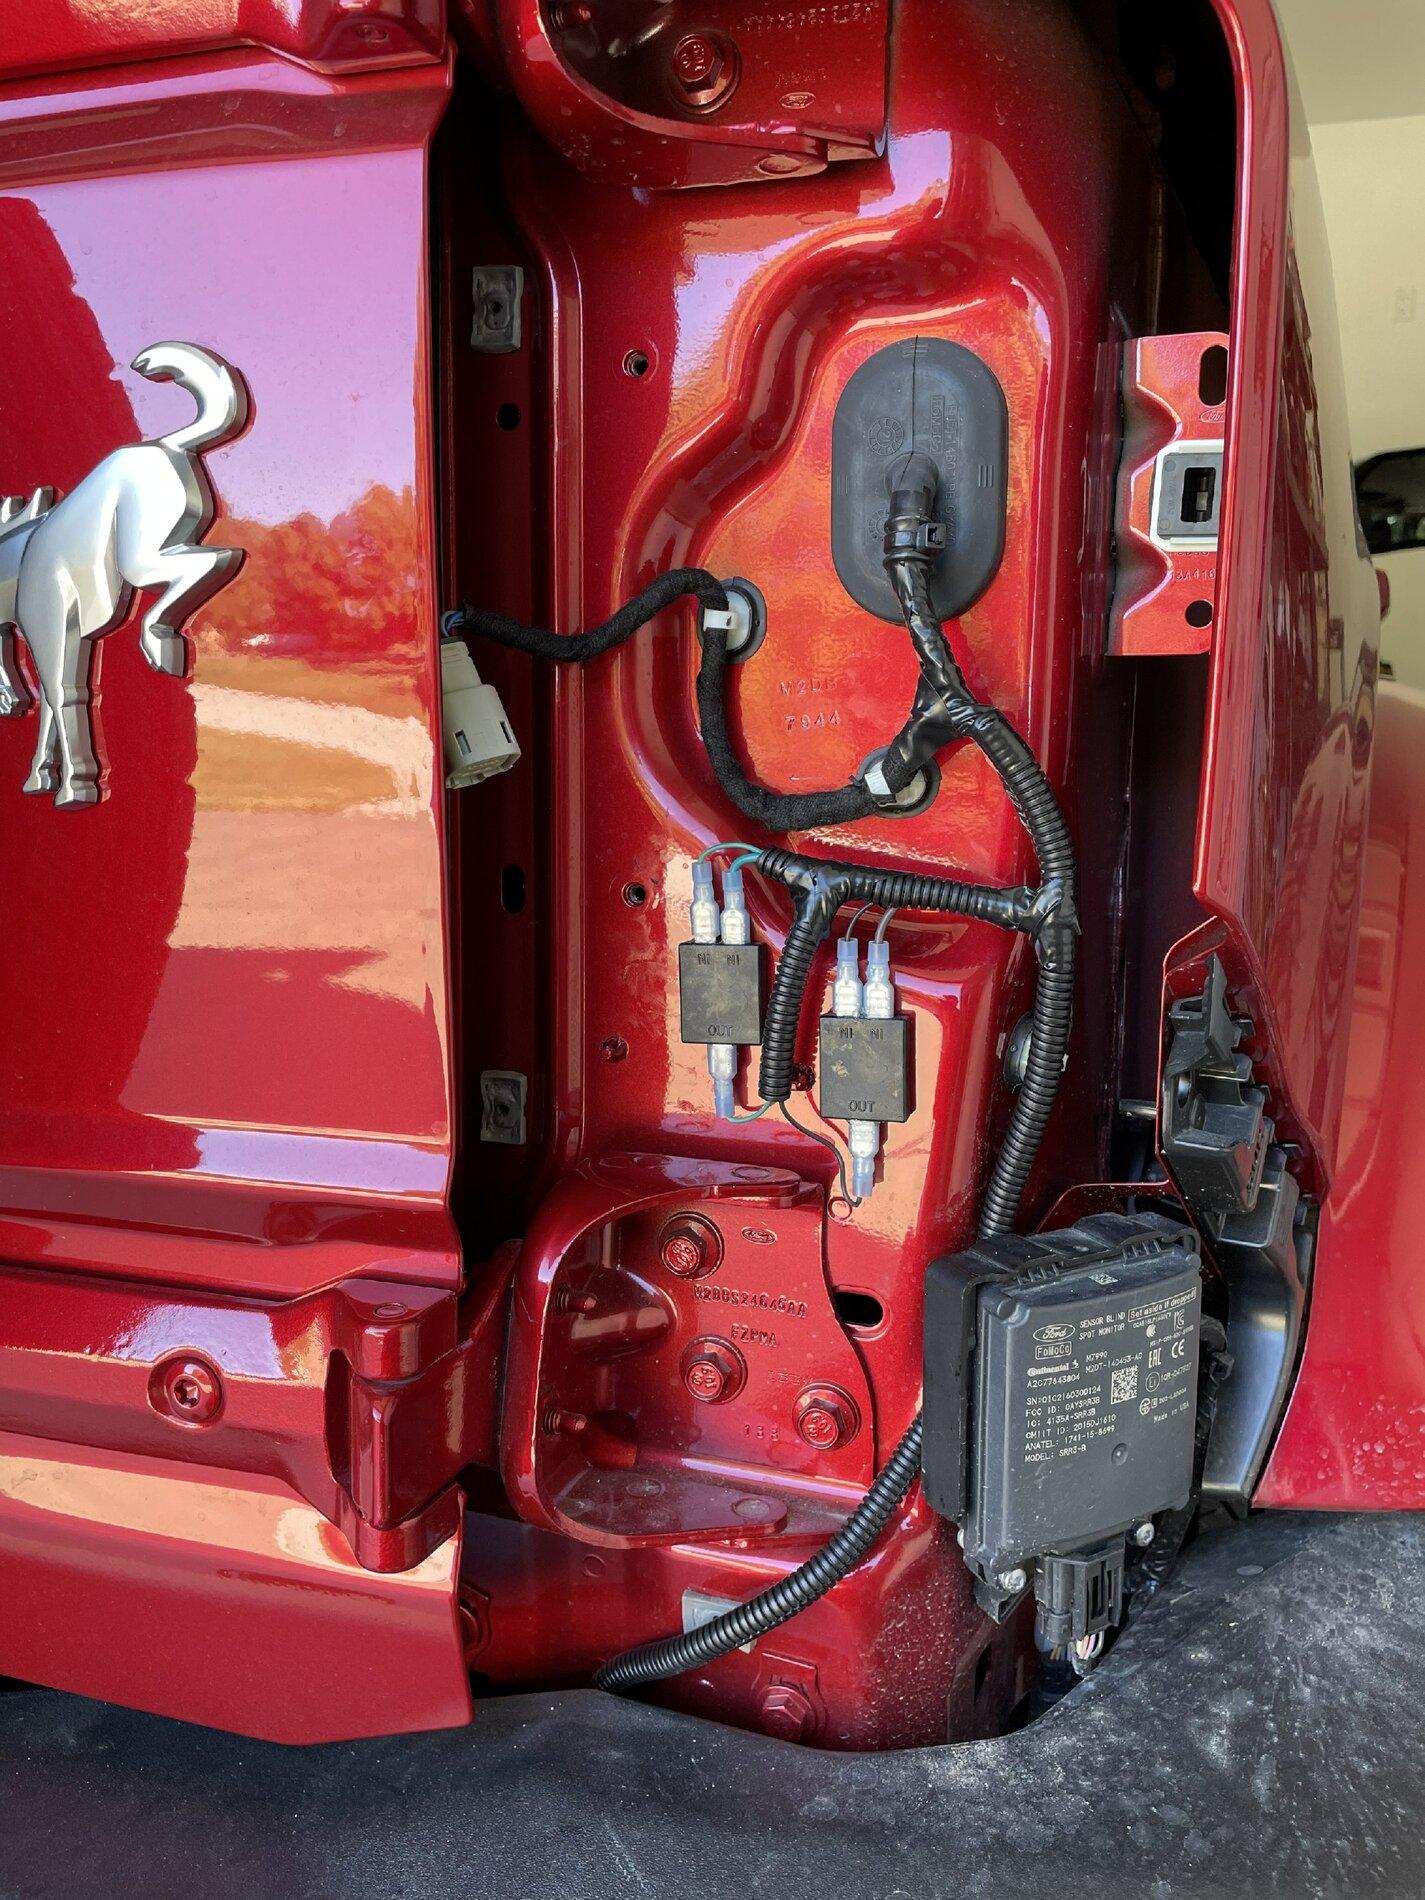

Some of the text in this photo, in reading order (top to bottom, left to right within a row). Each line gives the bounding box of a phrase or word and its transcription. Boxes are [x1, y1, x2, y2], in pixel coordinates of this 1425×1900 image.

[708, 1025, 733, 1037] OUT
[848, 1100, 875, 1113] OUT
[1081, 1311, 1126, 1328] SENSOR BLIND
[1130, 1310, 1143, 1319] Set
[1080, 1323, 1126, 1340] SPOT MONITOR
[1038, 1344, 1070, 1357] FoMoCo
[1025, 1408, 1042, 1418] FCC
[1048, 1405, 1061, 1414] ID:
[1028, 1419, 1041, 1428] IC:
[1026, 1428, 1052, 1438] CMIIT
[1057, 1426, 1070, 1435] ID:
[1025, 1439, 1060, 1451] ANATEL:
[1025, 1451, 1055, 1462] MODEL:
